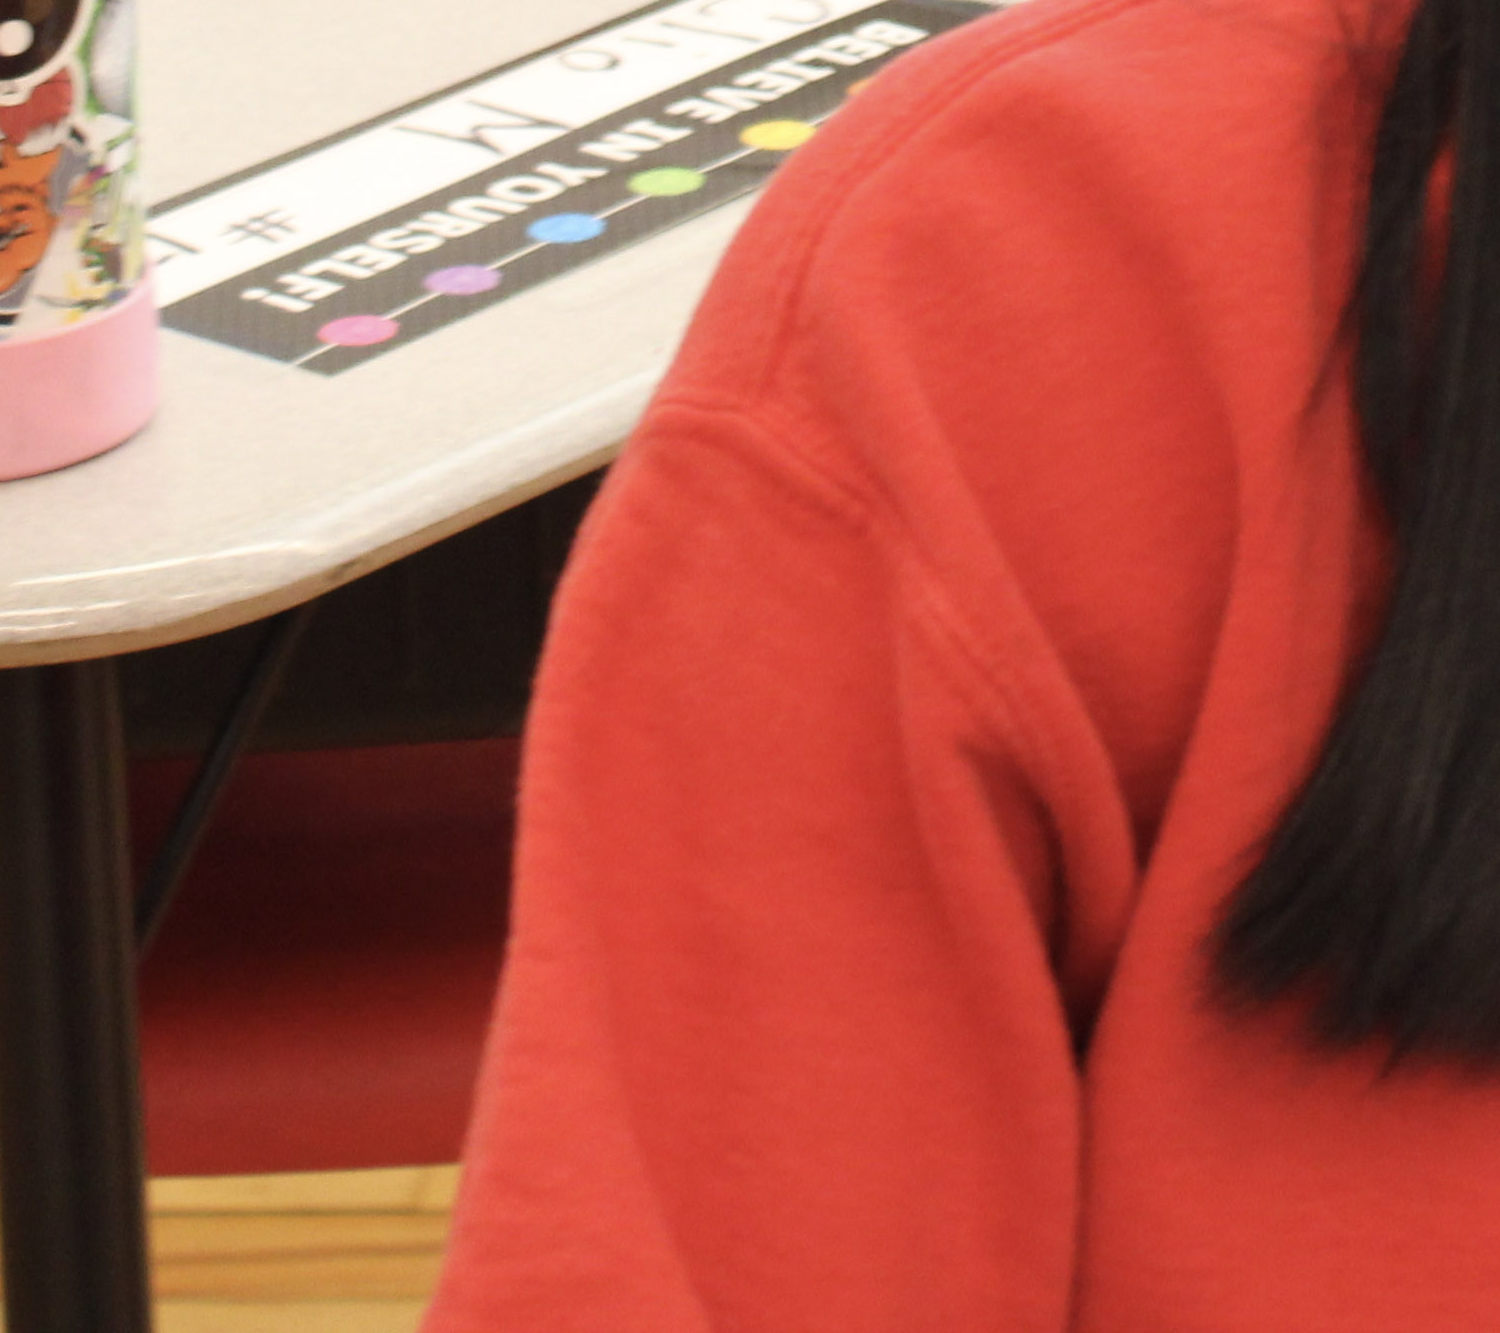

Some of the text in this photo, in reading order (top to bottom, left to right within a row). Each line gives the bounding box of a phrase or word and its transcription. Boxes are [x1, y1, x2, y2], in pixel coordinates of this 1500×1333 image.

[240, 18, 930, 314] BELIEVE IN YOURSELF!
